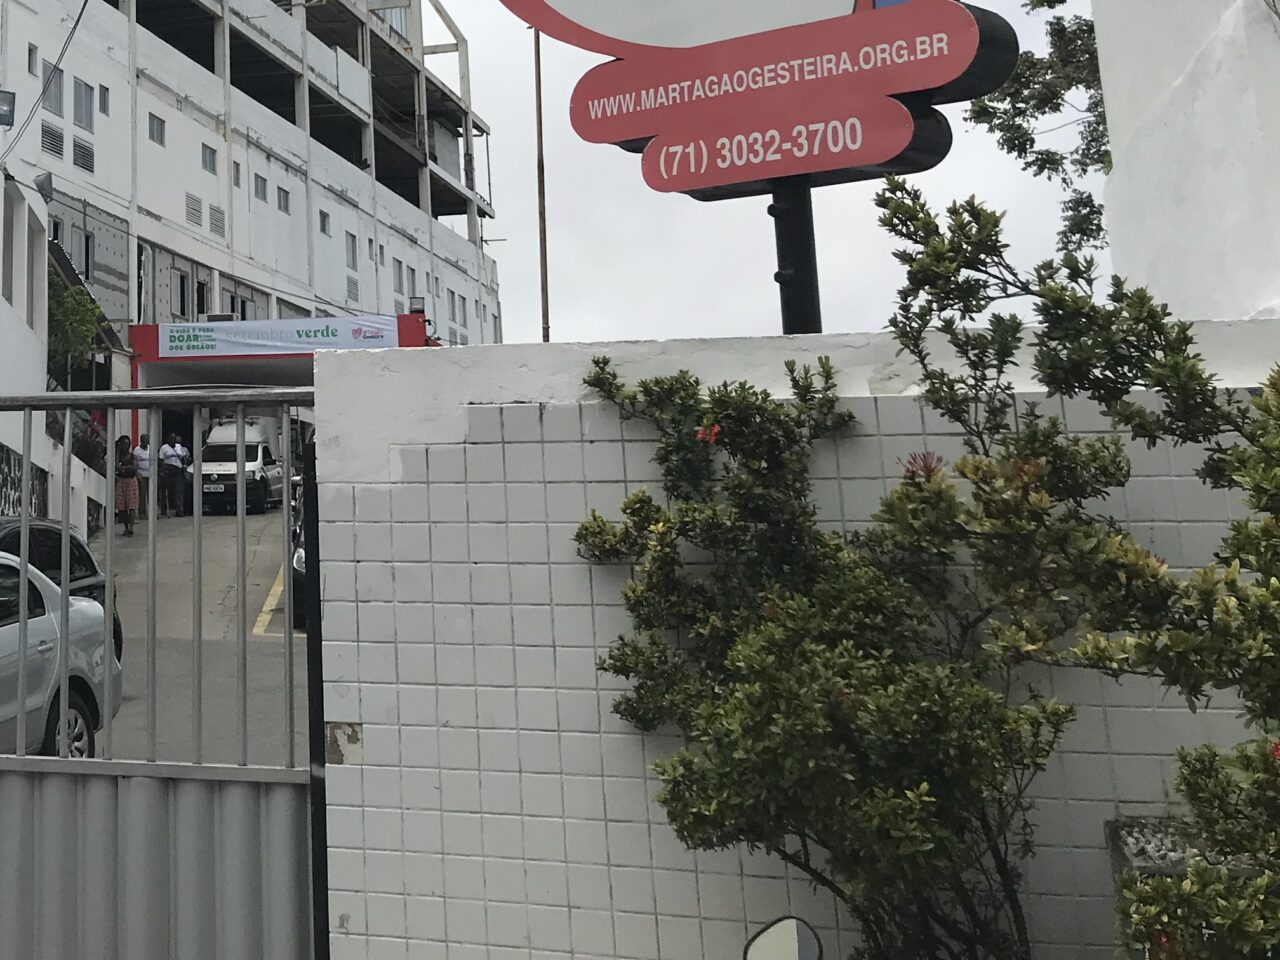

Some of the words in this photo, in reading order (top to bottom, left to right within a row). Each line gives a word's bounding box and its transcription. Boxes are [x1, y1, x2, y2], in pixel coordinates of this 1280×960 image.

[588, 32, 950, 120] WWW.MARTAGAOGESTEIRA.ORG.BR
[658, 140, 709, 179] (71)
[716, 116, 862, 169] 3032-3700
[169, 334, 199, 343] DOAR
[296, 324, 339, 339] verde
